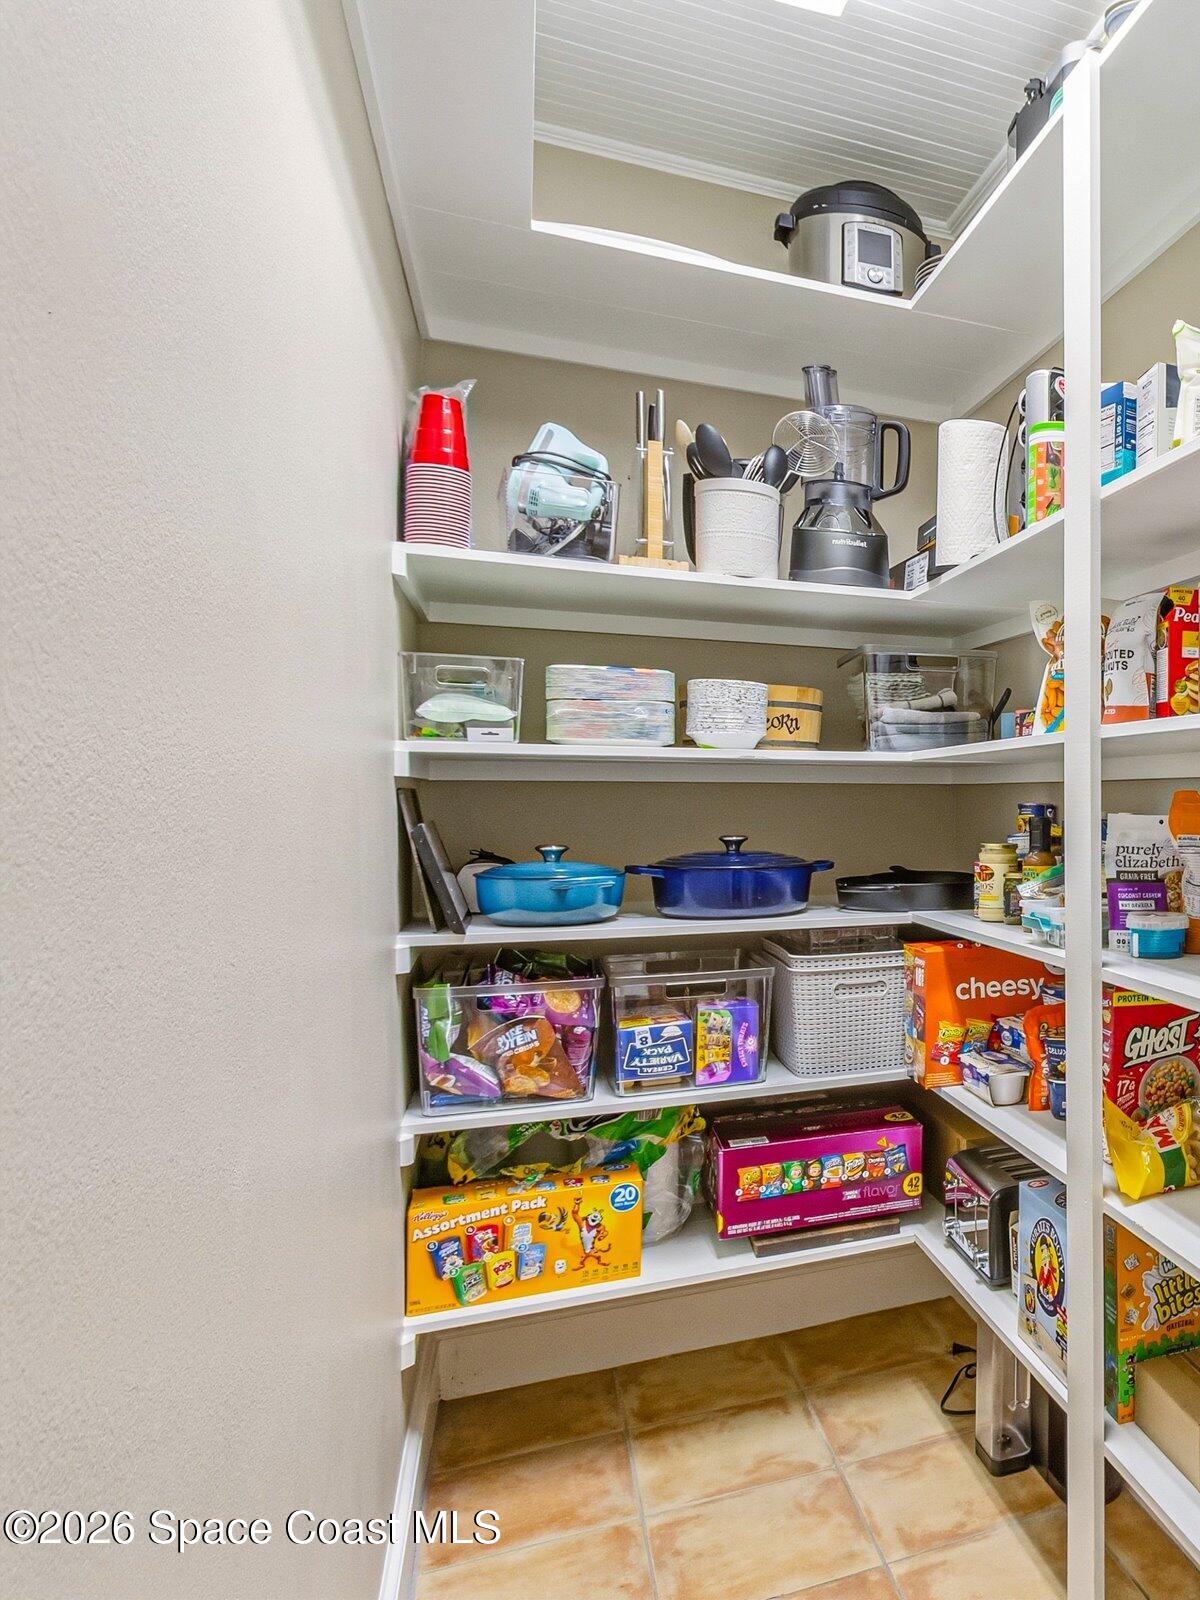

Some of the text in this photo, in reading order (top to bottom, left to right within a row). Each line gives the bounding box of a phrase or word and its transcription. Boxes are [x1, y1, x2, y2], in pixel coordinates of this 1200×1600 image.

[832, 538, 868, 548] nutribullet
[1115, 843, 1164, 859] purely
[955, 976, 1045, 1000] cheesy
[1123, 1012, 1200, 1064] GHOST
[641, 1044, 674, 1056] PACK
[629, 1051, 685, 1066] VARIETY
[642, 1064, 673, 1073] CEREAL
[907, 1176, 920, 1189] 42
[614, 1187, 636, 1203] 20
[863, 1184, 900, 1197] flavor
[412, 1196, 547, 1242] Assortment Pack
